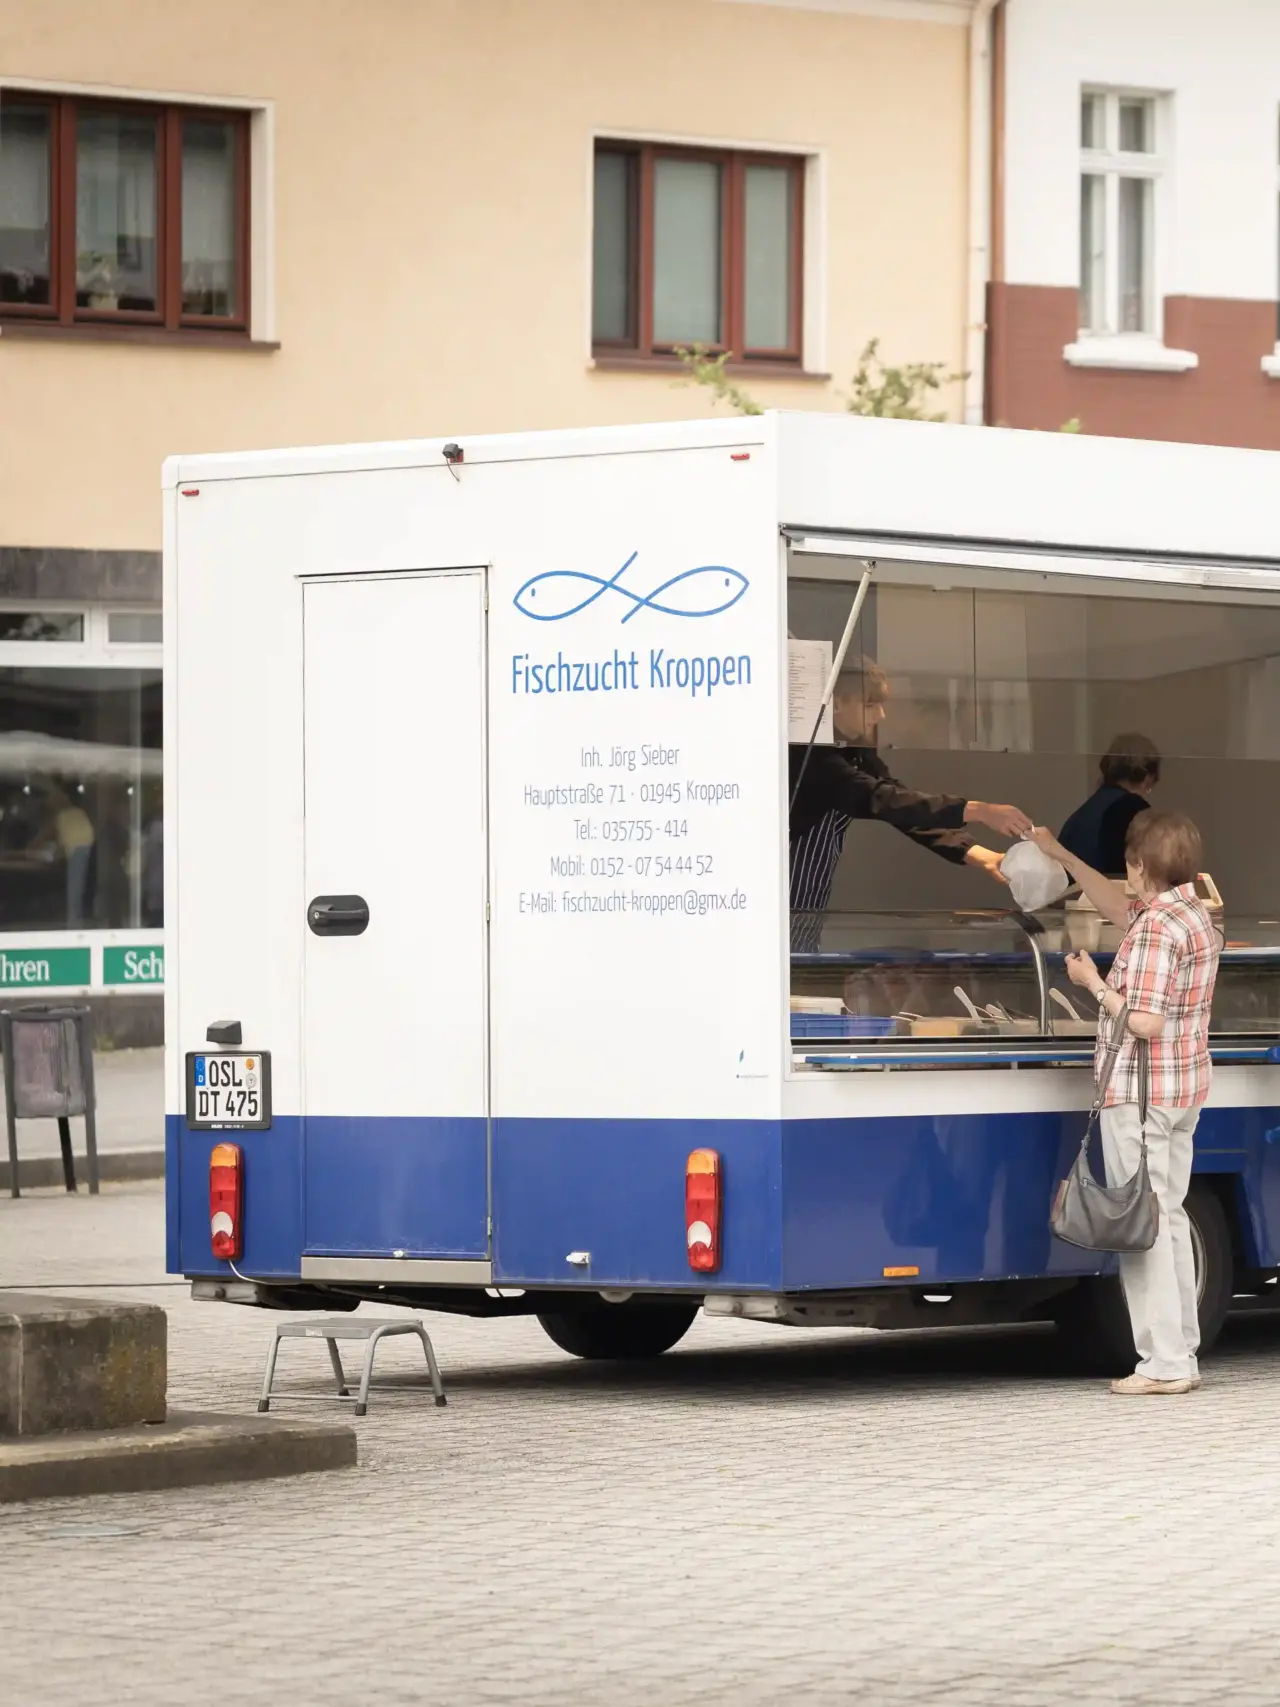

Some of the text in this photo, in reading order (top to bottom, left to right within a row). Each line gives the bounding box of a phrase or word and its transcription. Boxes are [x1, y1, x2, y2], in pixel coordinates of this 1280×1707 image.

[512, 648, 639, 694] Fischzucht
[650, 648, 751, 697] Kroppen
[580, 742, 680, 771] Inh. Jörg Sieber
[524, 783, 604, 809] Hauptstraße
[610, 784, 626, 805] 71
[640, 782, 681, 804] 01945
[686, 780, 740, 806] Kroppen
[574, 818, 597, 840] Tel.:
[602, 820, 652, 842] 035755
[664, 819, 689, 838] 414
[550, 855, 585, 878] Mobil:
[590, 857, 624, 878] 0152
[519, 887, 747, 916] E-Mail: fischzucht-kroppen@gmx.de
[198, 1075, 204, 1083] D
[209, 1060, 243, 1087] OSL
[199, 1091, 258, 1117] DT 475
